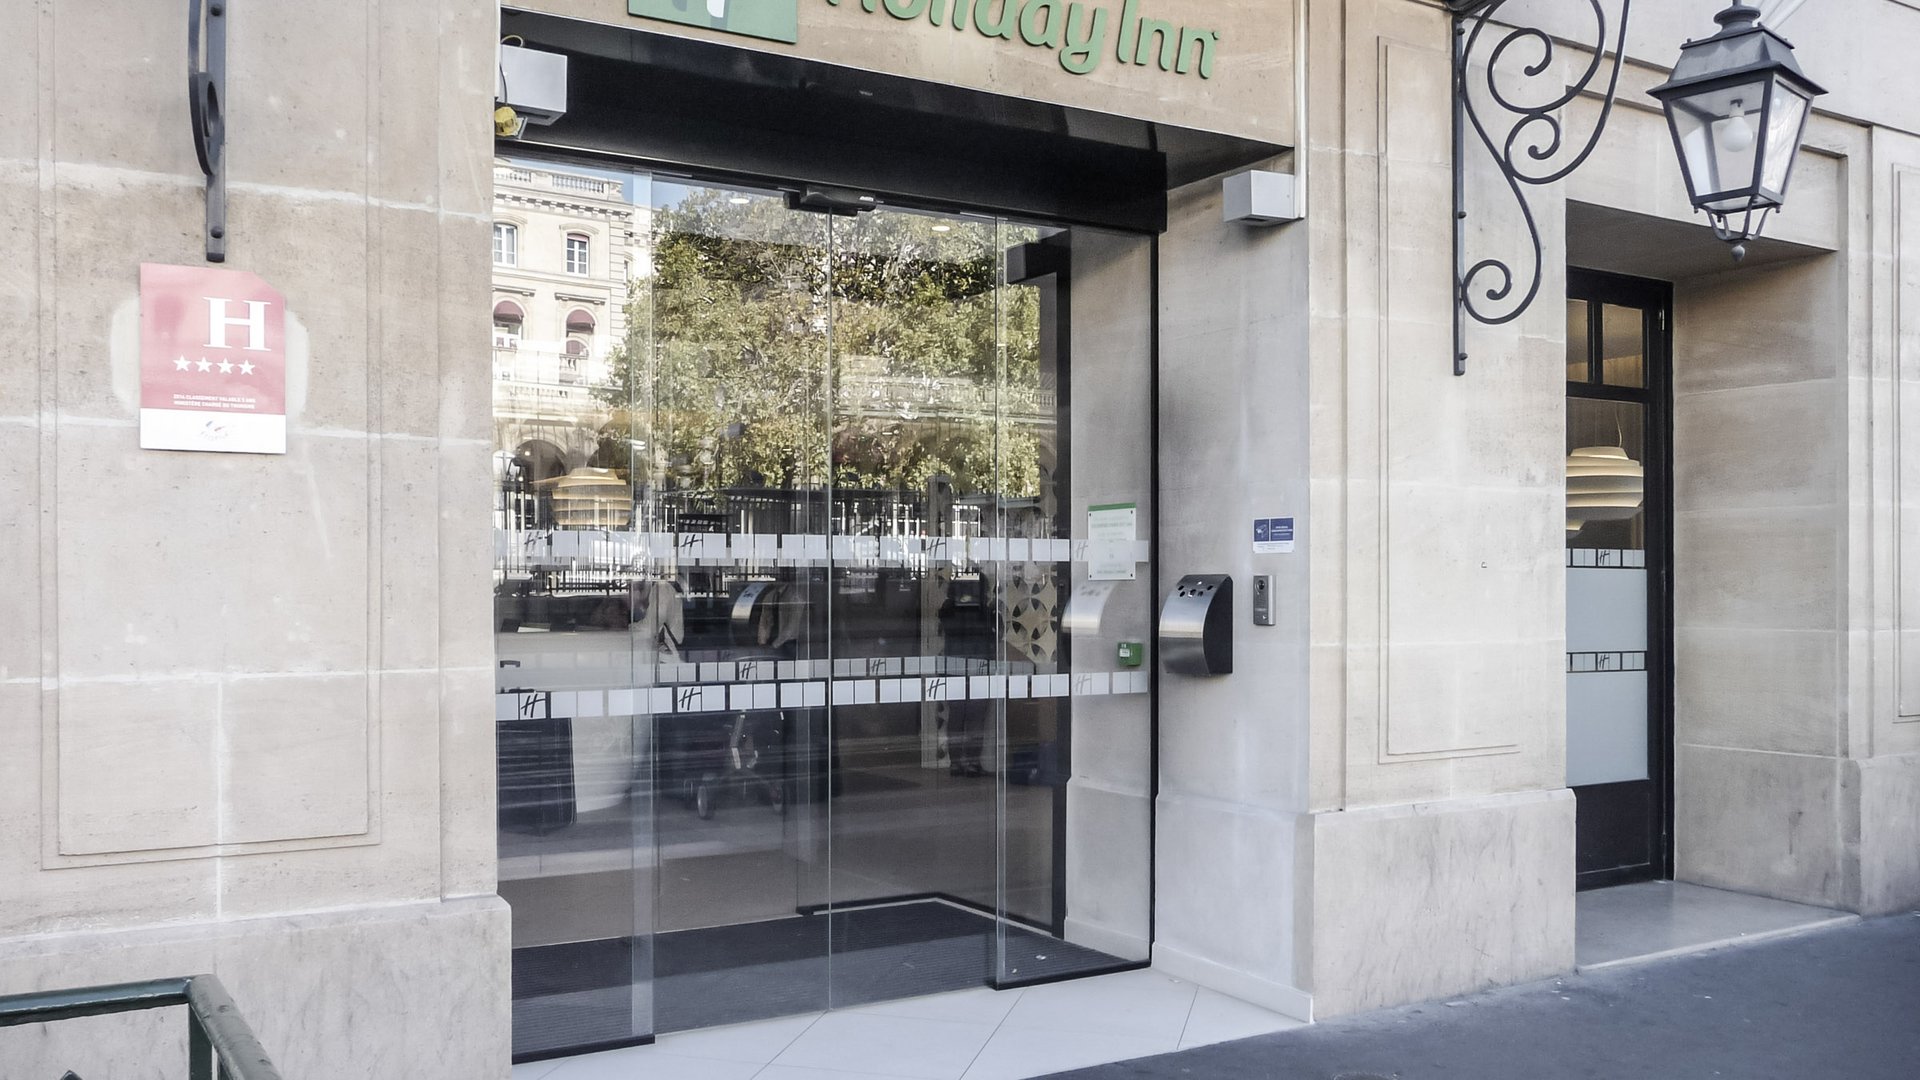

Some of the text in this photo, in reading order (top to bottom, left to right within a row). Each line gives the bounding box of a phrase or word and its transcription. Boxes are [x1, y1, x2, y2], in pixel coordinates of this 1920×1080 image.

[826, 0, 1217, 78] iday Inn
[203, 297, 272, 351] H
[678, 687, 702, 711] H
[927, 678, 946, 700] H
[520, 693, 547, 718] H
